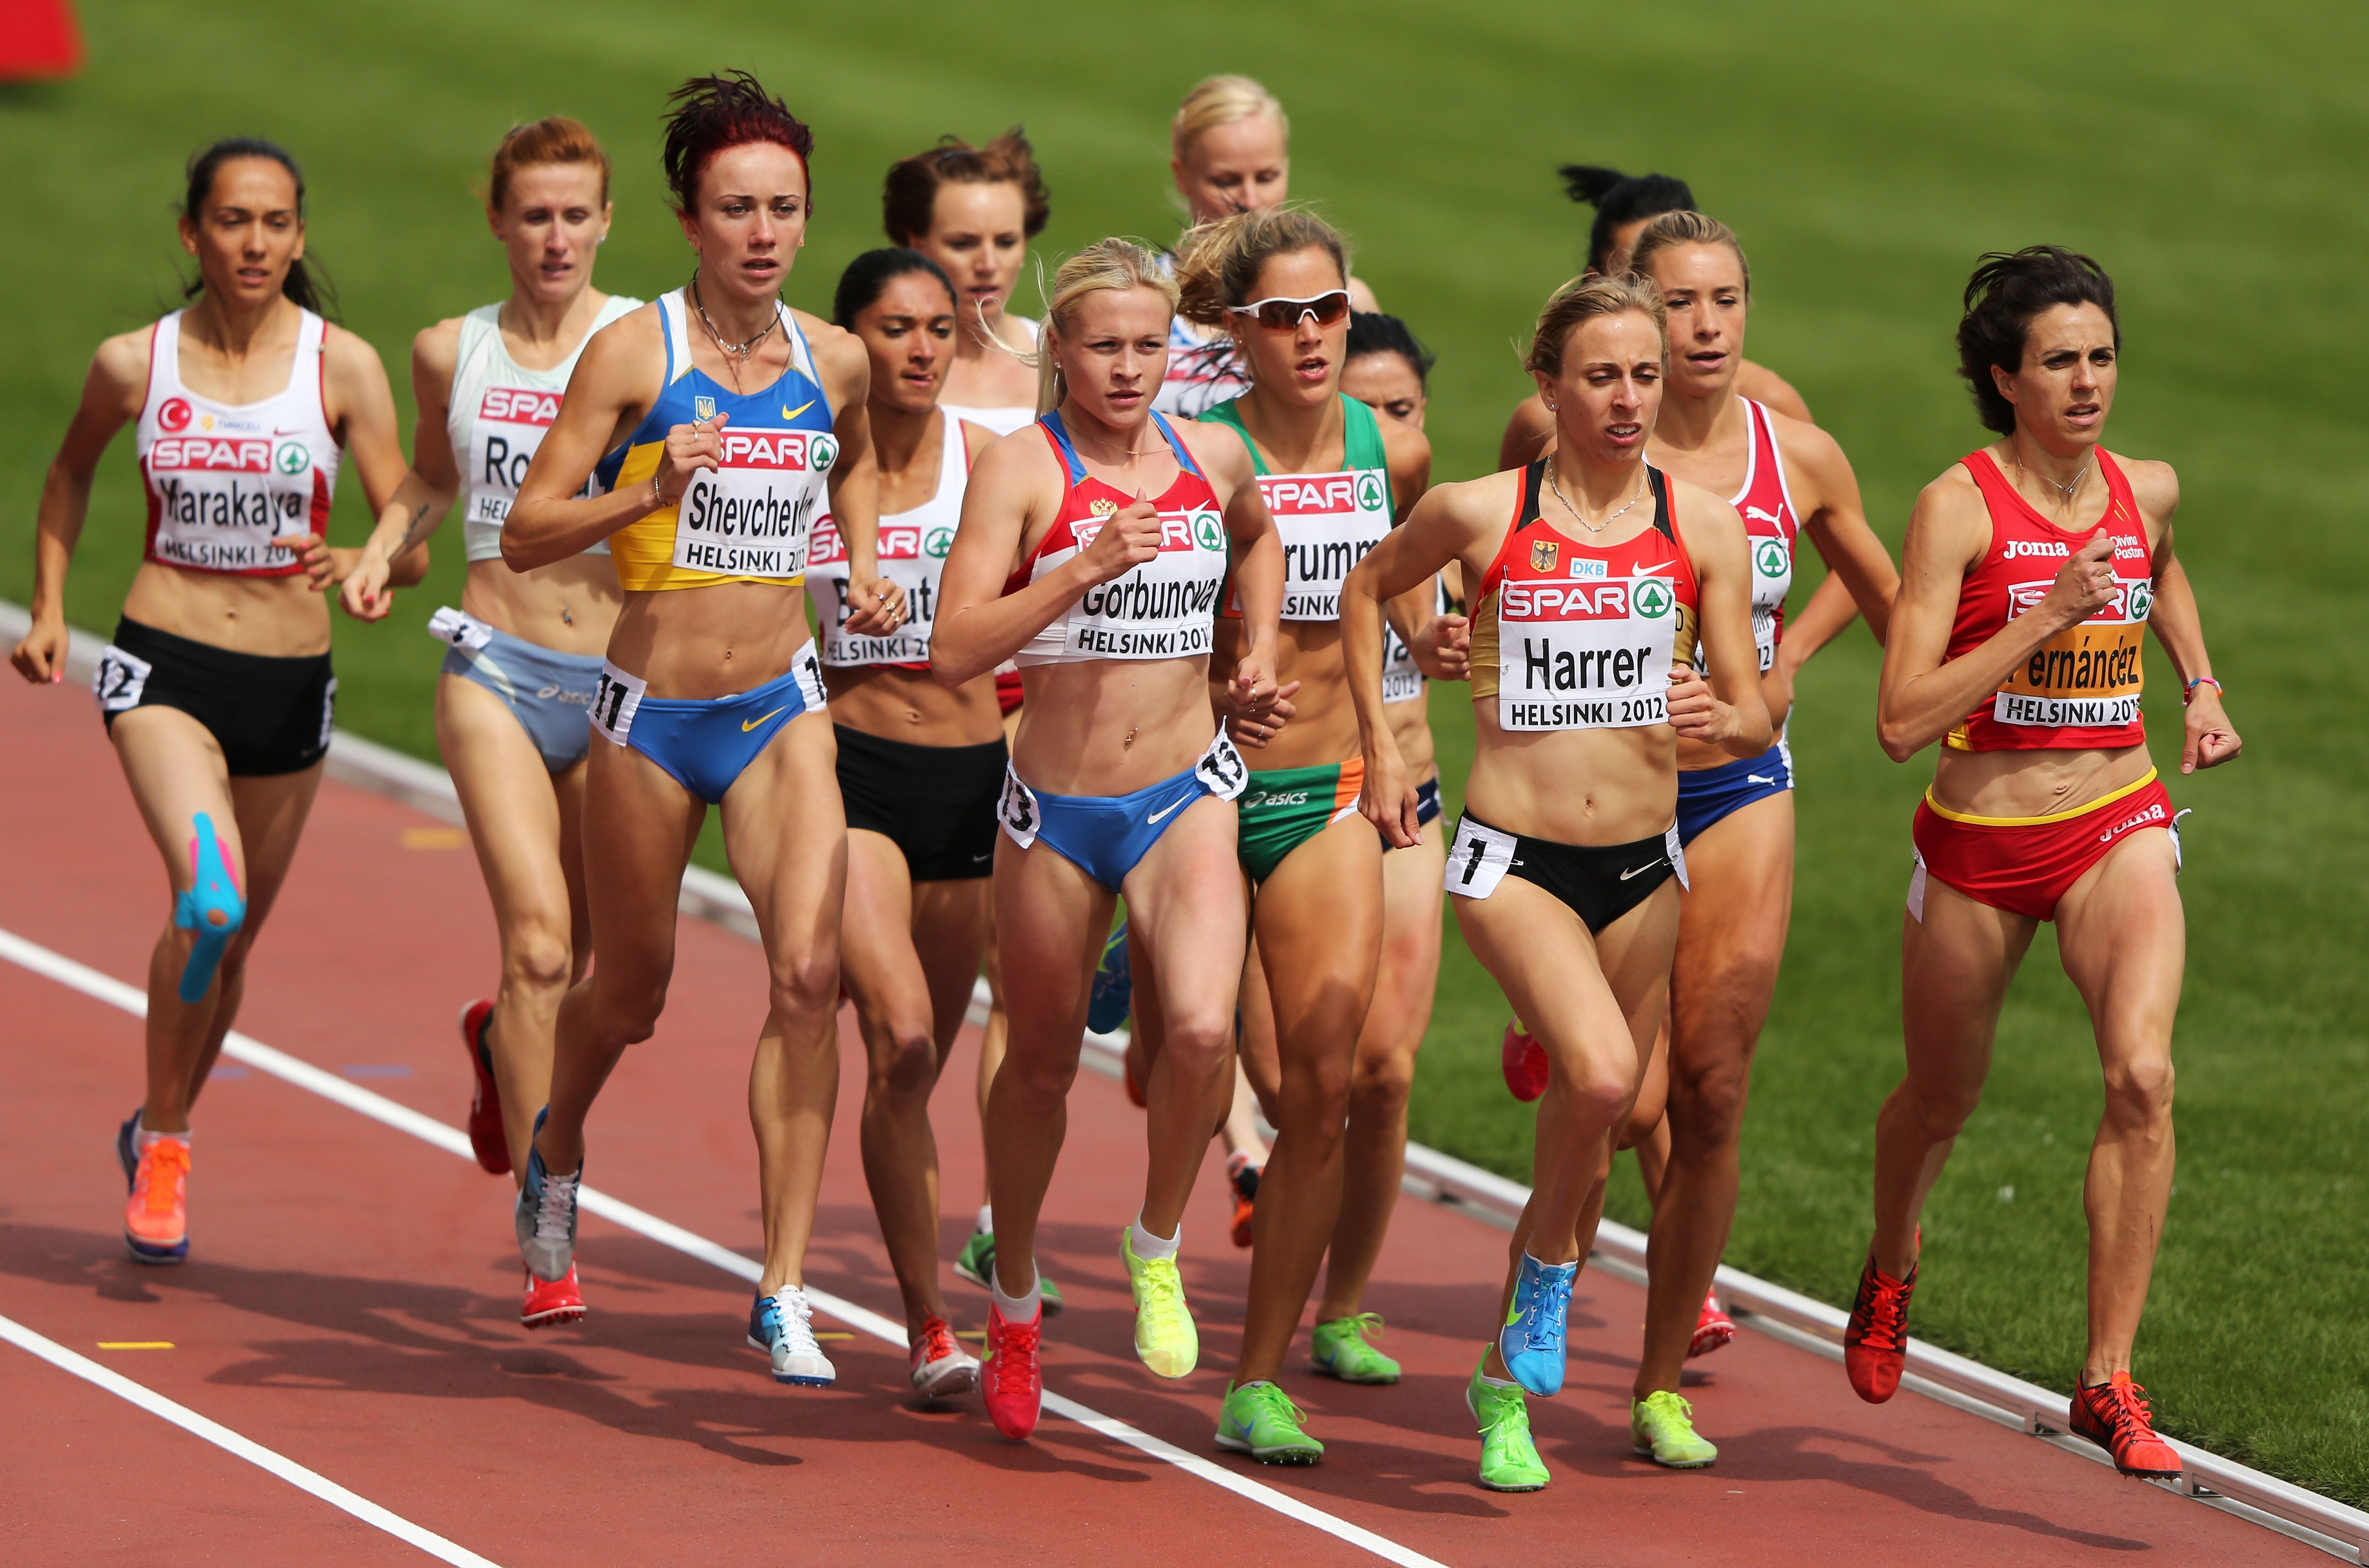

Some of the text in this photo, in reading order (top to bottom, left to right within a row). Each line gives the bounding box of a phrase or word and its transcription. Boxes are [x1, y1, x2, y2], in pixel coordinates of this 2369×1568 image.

[483, 391, 559, 422] SPA
[155, 439, 269, 470] SPAR
[165, 539, 256, 564] HELSINKI
[2109, 534, 2138, 548] Divina
[2114, 548, 2145, 560] Pastora
[686, 543, 781, 572] HELSINKI
[1572, 562, 1604, 577] DKB
[1083, 570, 1217, 620] Gorbunova
[1505, 587, 1626, 617] SPAR
[1078, 627, 1209, 654] HELSINKI 201
[1524, 638, 1652, 690] Harrer
[1385, 673, 1414, 697] 2012
[595, 673, 629, 732] 11
[1512, 697, 1663, 726] HELSINKI 2012
[2006, 698, 2104, 724] HELSINKI
[1265, 792, 1308, 806] asics
[1461, 837, 1487, 885] 1
